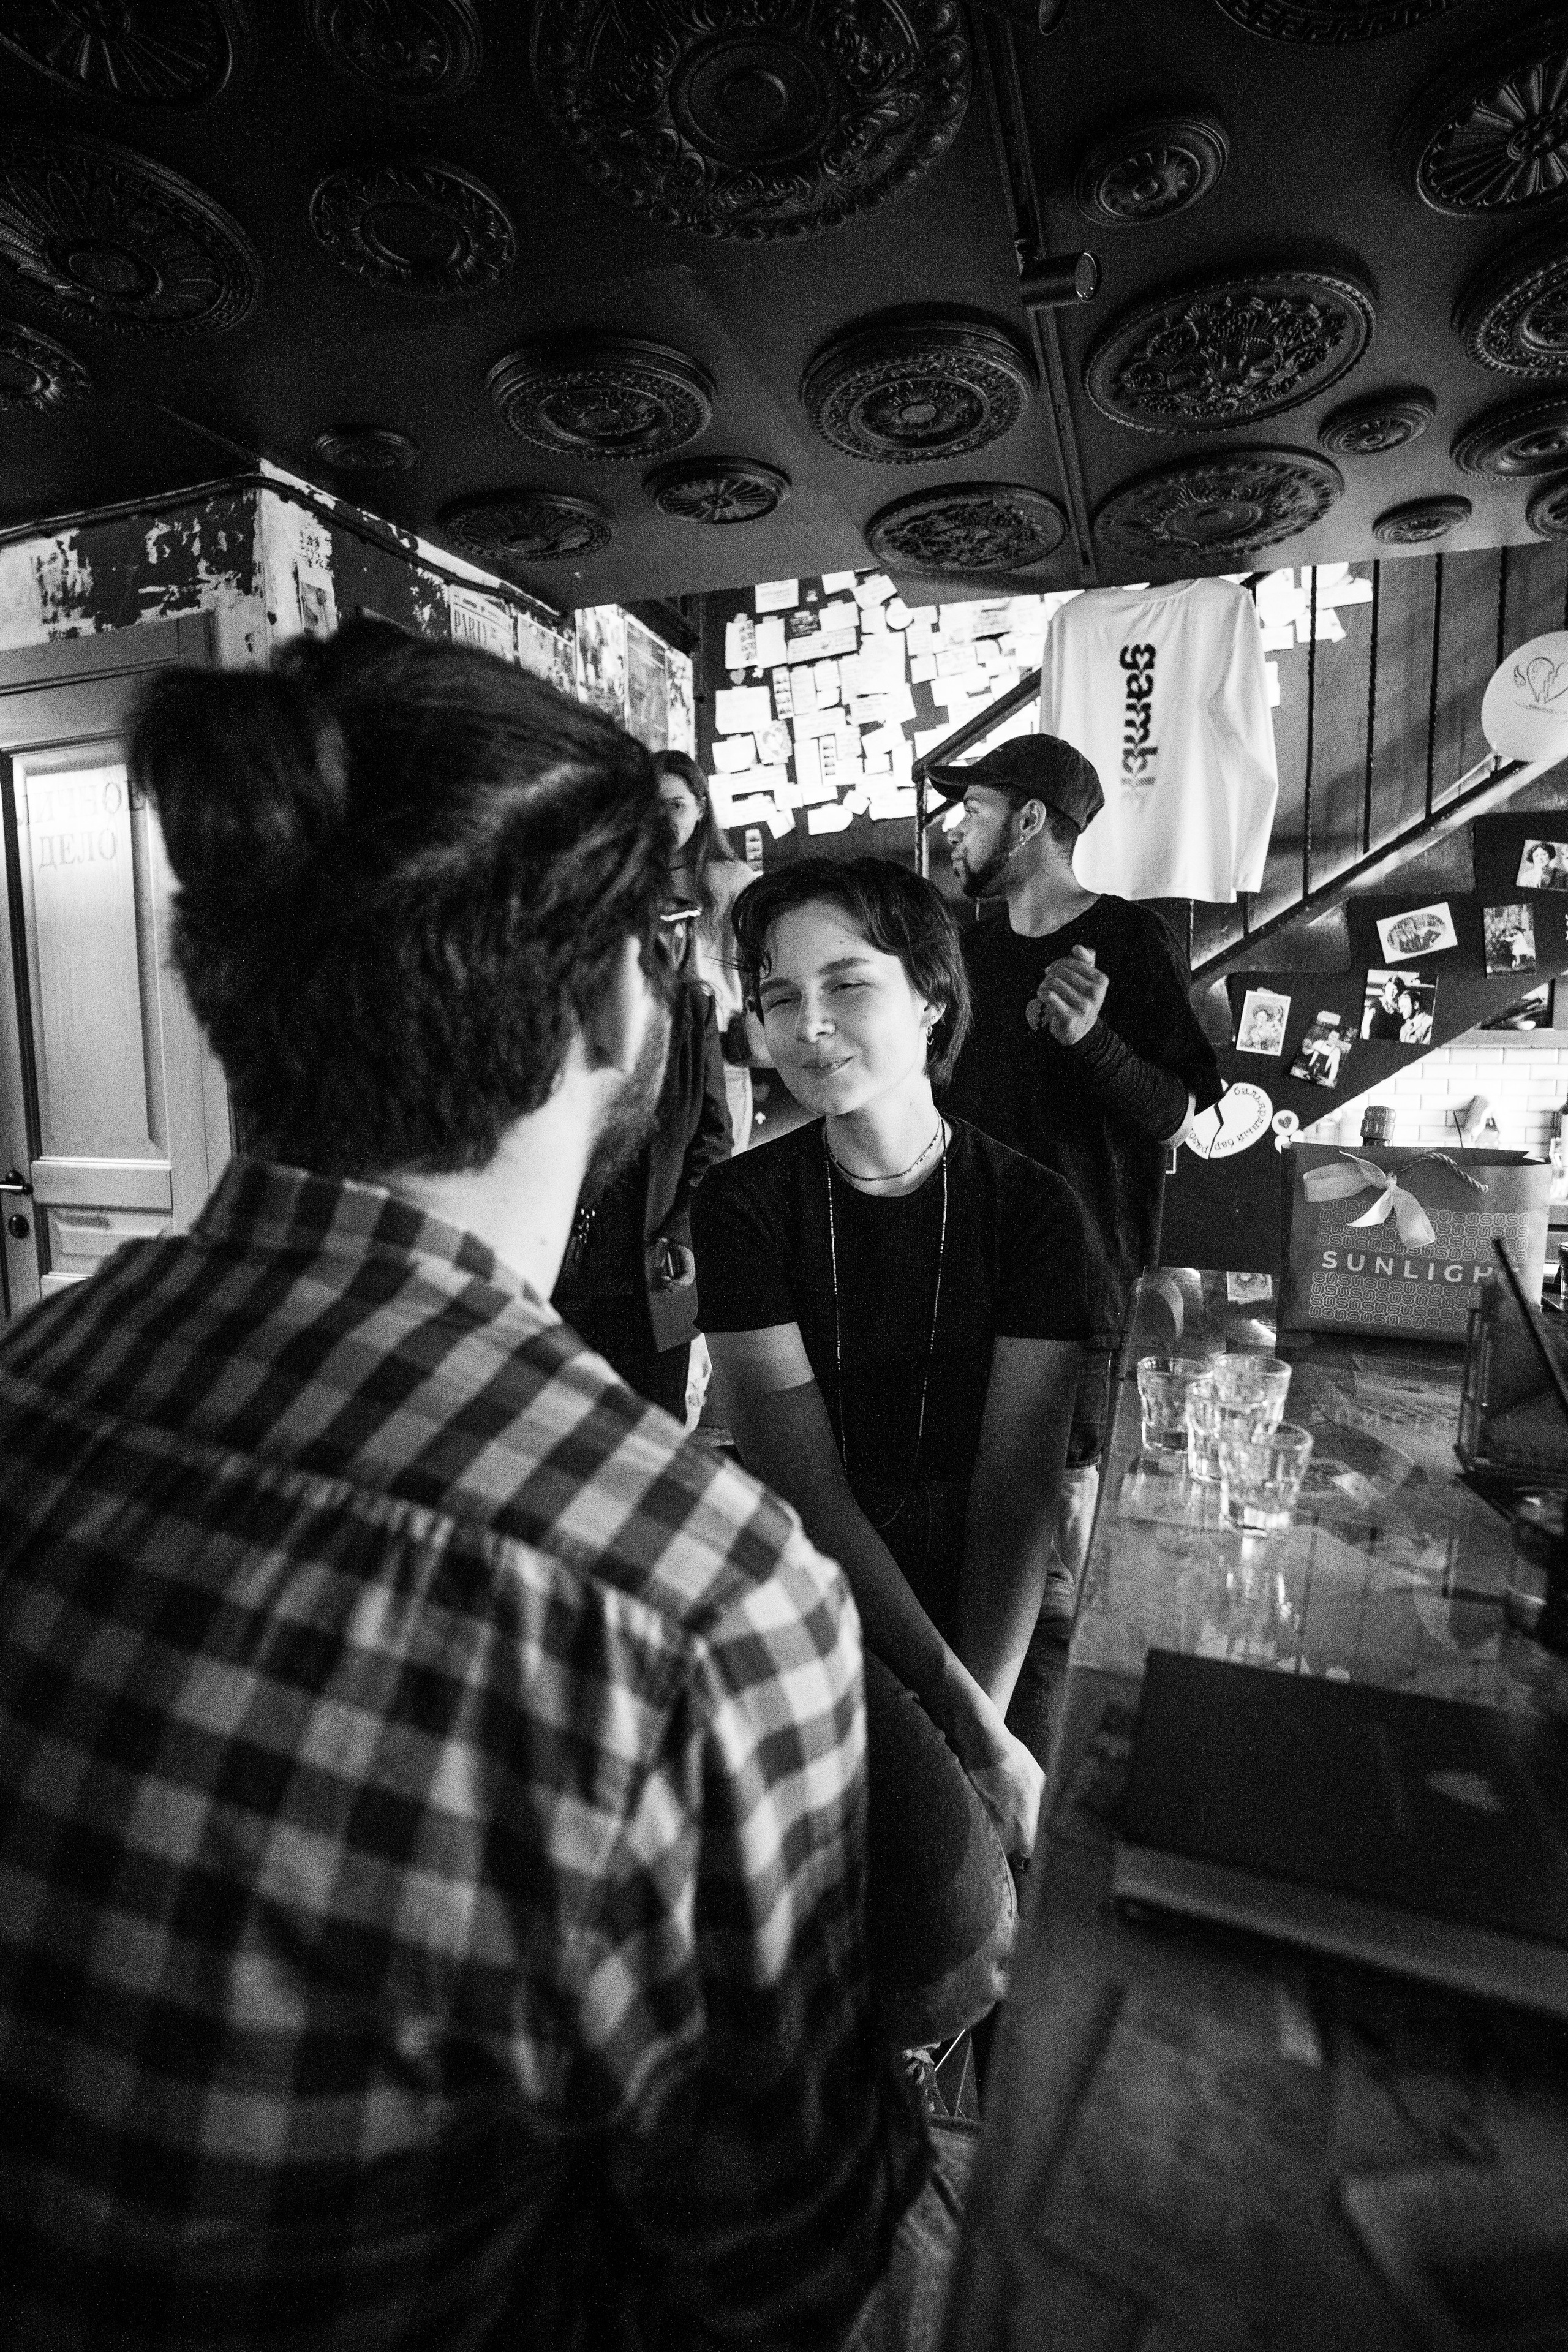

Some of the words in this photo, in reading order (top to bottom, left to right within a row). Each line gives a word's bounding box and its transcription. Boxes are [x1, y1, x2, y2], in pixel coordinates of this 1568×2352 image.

[38, 827, 118, 873] ДЕЛО
[1188, 1128, 1208, 1153] разб
[1214, 1138, 1235, 1151] бар
[1321, 1250, 1519, 1284] SUNLIGH
